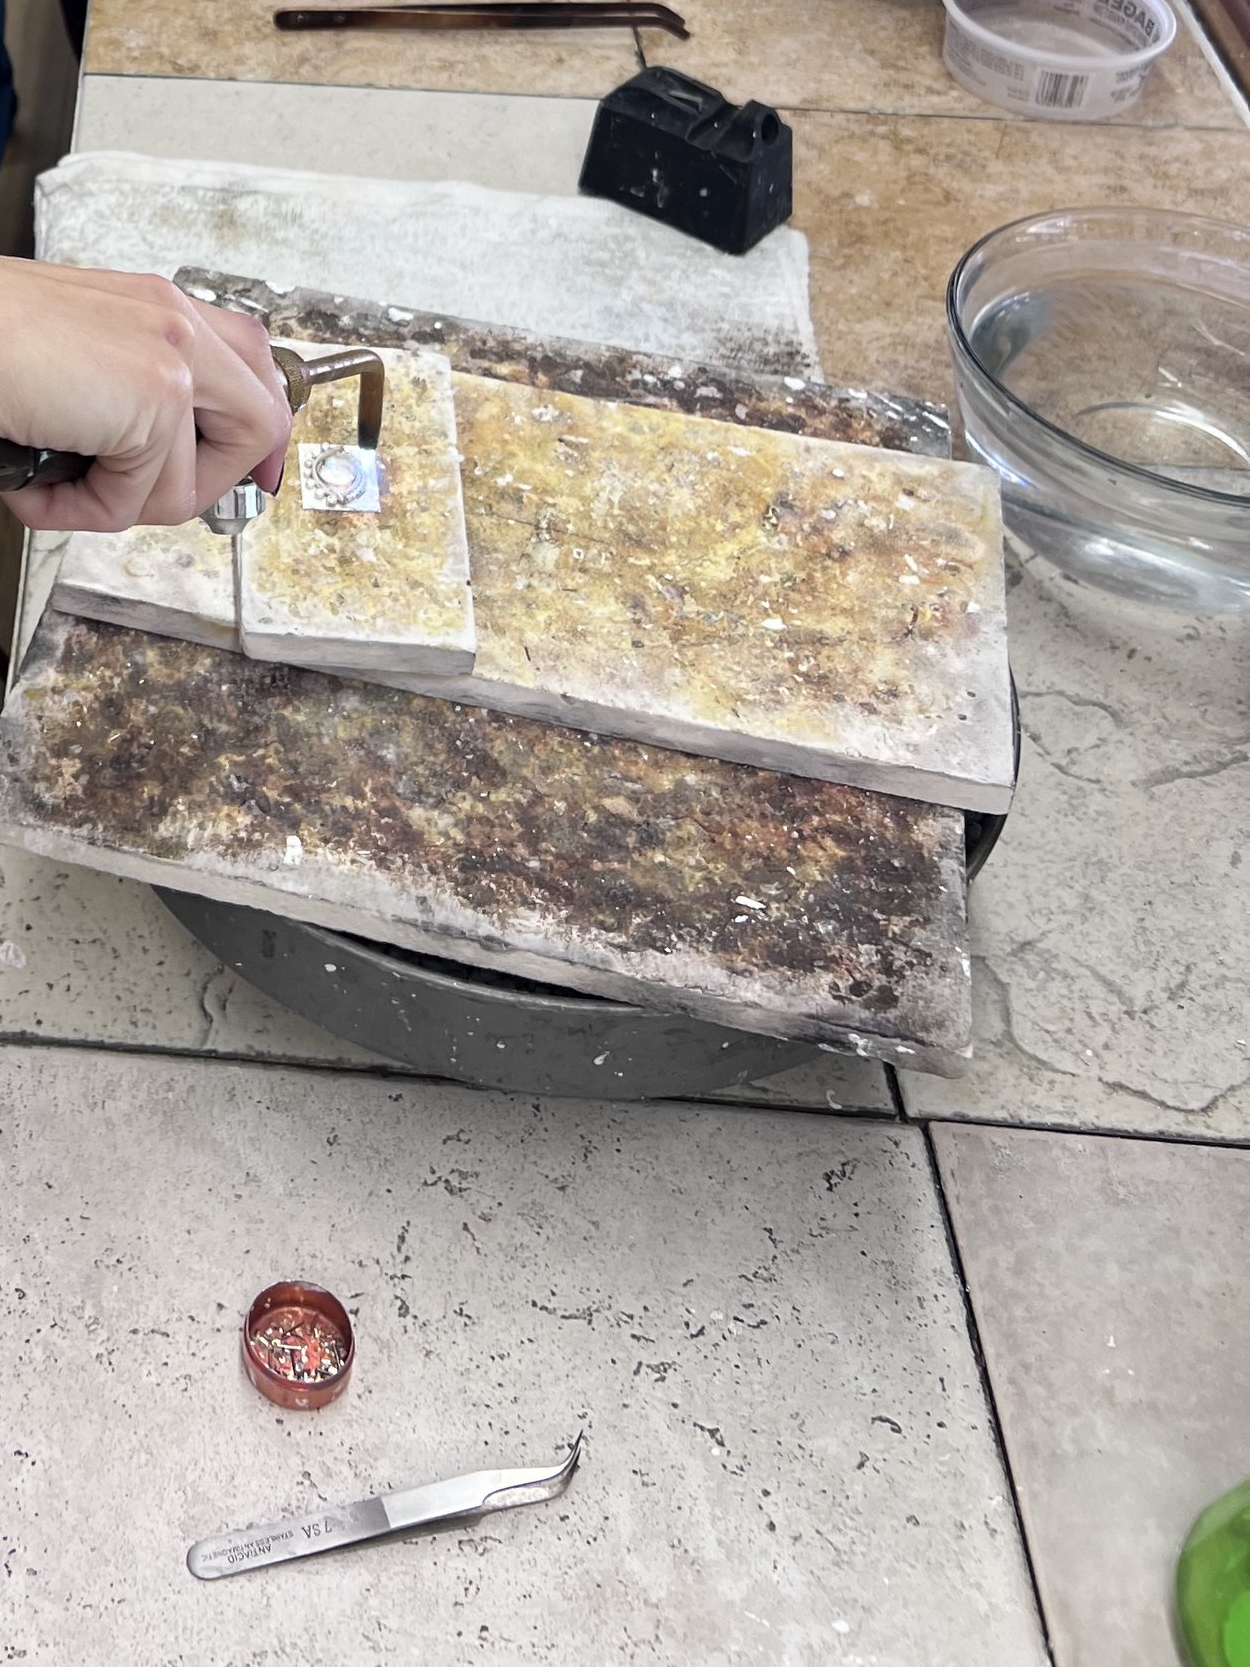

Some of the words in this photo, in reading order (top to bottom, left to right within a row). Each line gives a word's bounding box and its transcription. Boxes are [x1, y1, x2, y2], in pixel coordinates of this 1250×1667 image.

[255, 1530, 294, 1547] STAINLESS
[302, 1523, 321, 1538] SA
[227, 1544, 272, 1564] ANTIACID
